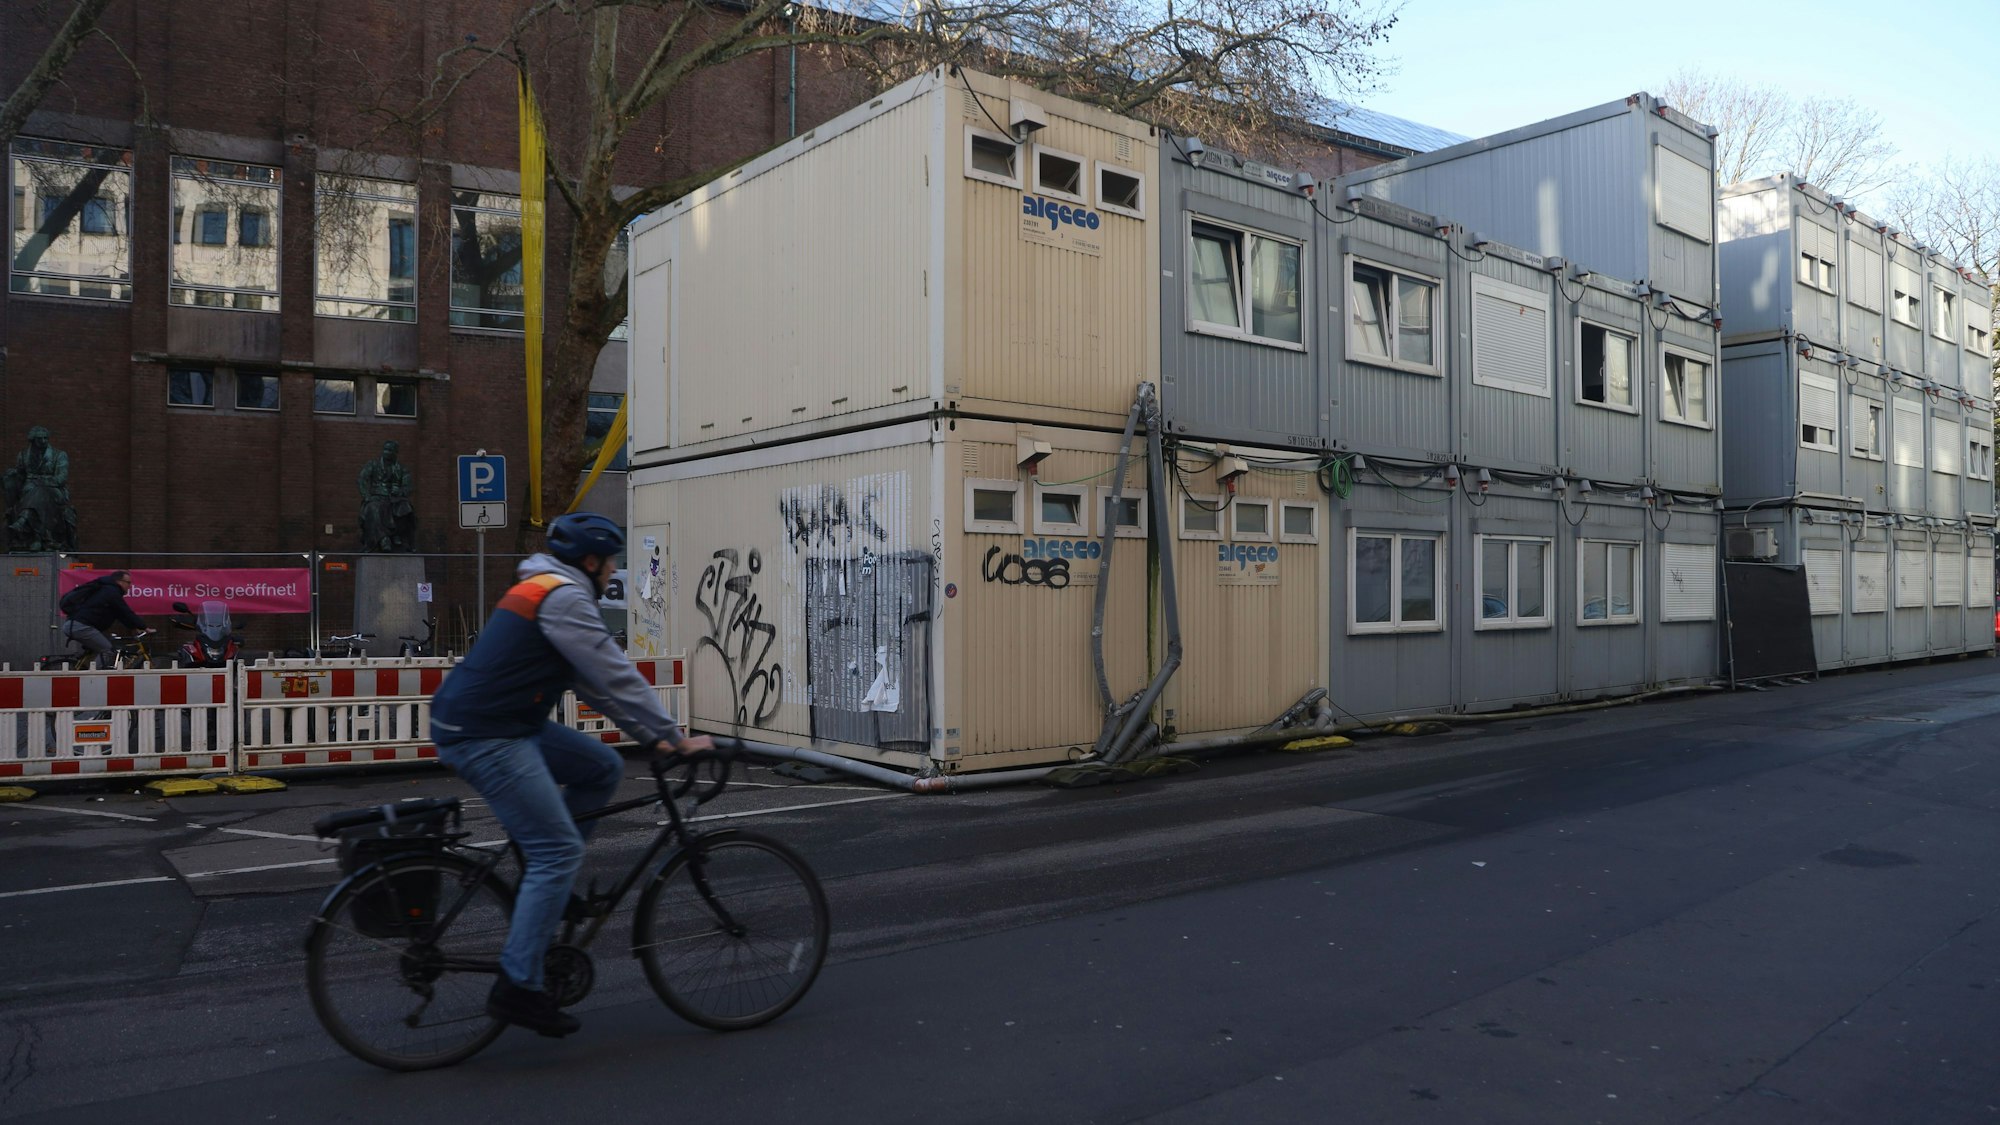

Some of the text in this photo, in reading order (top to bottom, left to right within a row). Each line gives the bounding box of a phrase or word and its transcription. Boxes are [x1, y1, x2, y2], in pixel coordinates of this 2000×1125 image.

[1023, 195, 1100, 231] algeco
[470, 462, 495, 498] P
[1219, 543, 1278, 571] algeco
[167, 583, 190, 597] für
[195, 583, 220, 597] Sie
[224, 583, 296, 599] geöffnet!
